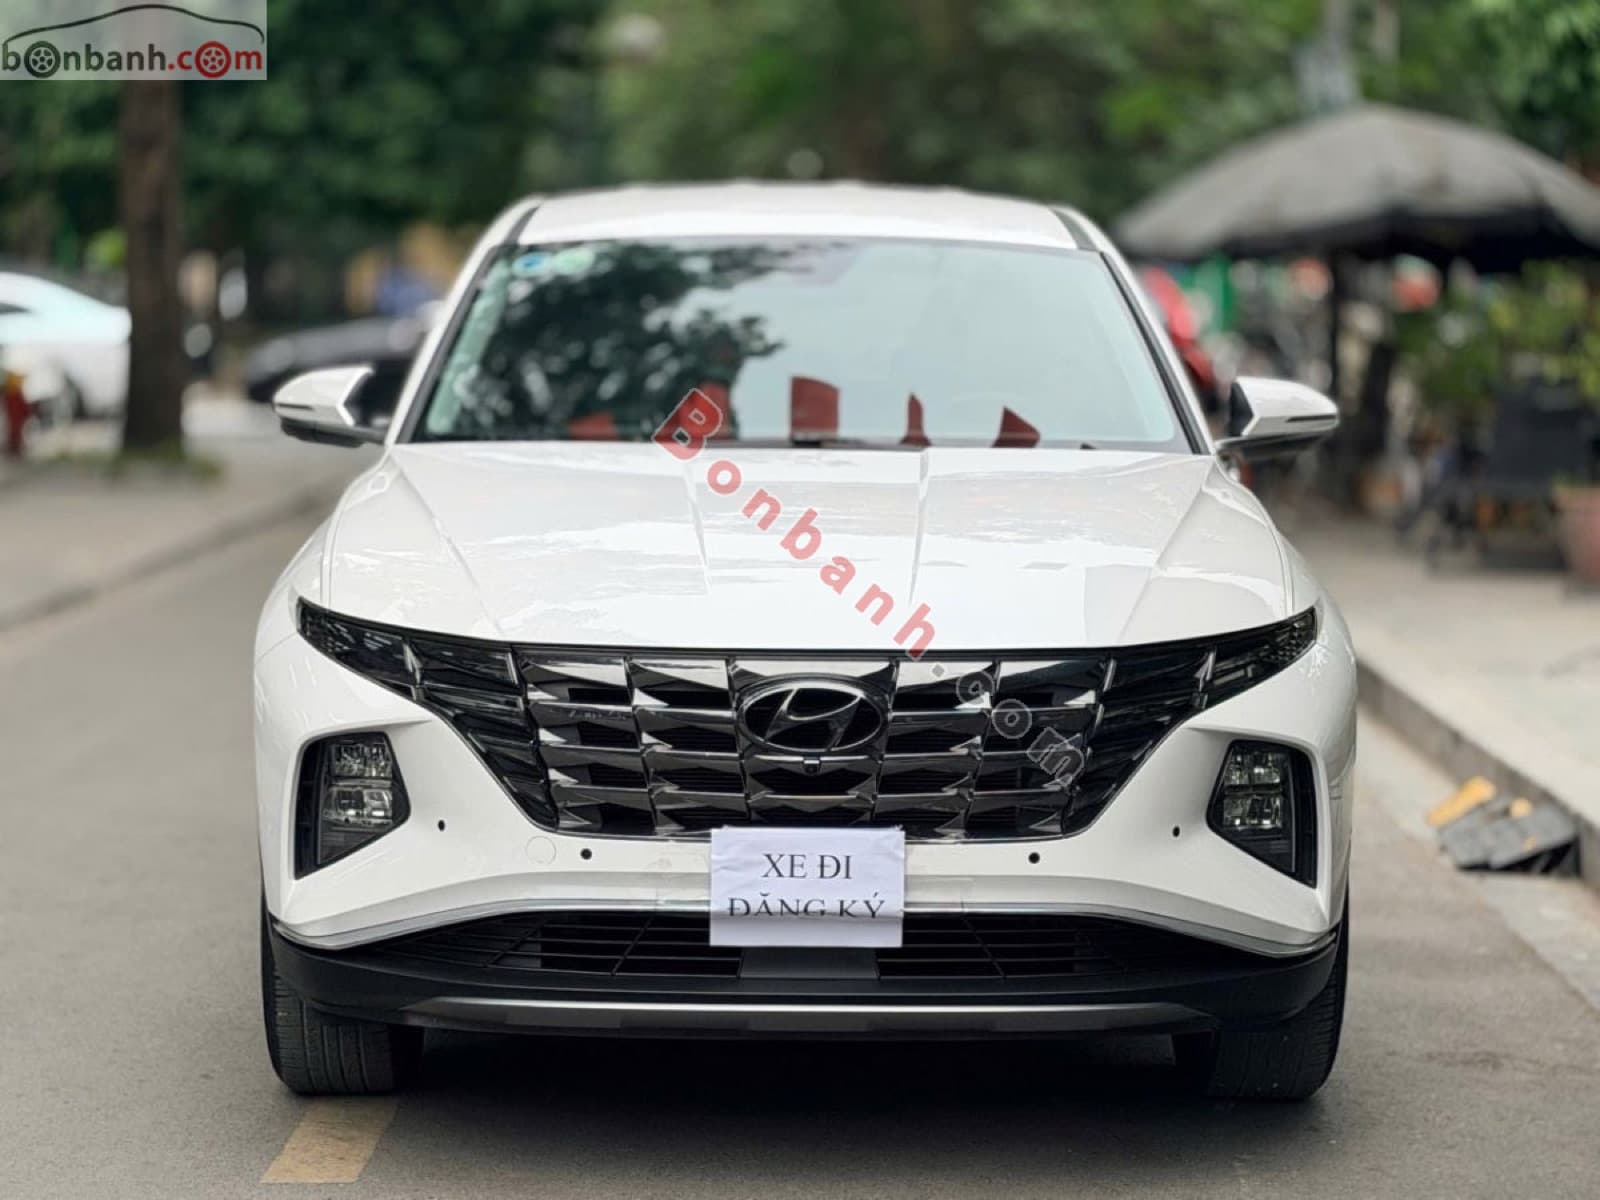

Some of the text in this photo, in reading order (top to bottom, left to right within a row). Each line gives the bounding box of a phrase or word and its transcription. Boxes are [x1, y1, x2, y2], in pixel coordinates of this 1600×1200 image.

[762, 853, 852, 879] XE ĐI
[727, 891, 885, 918] ĐĂNG KÝ
